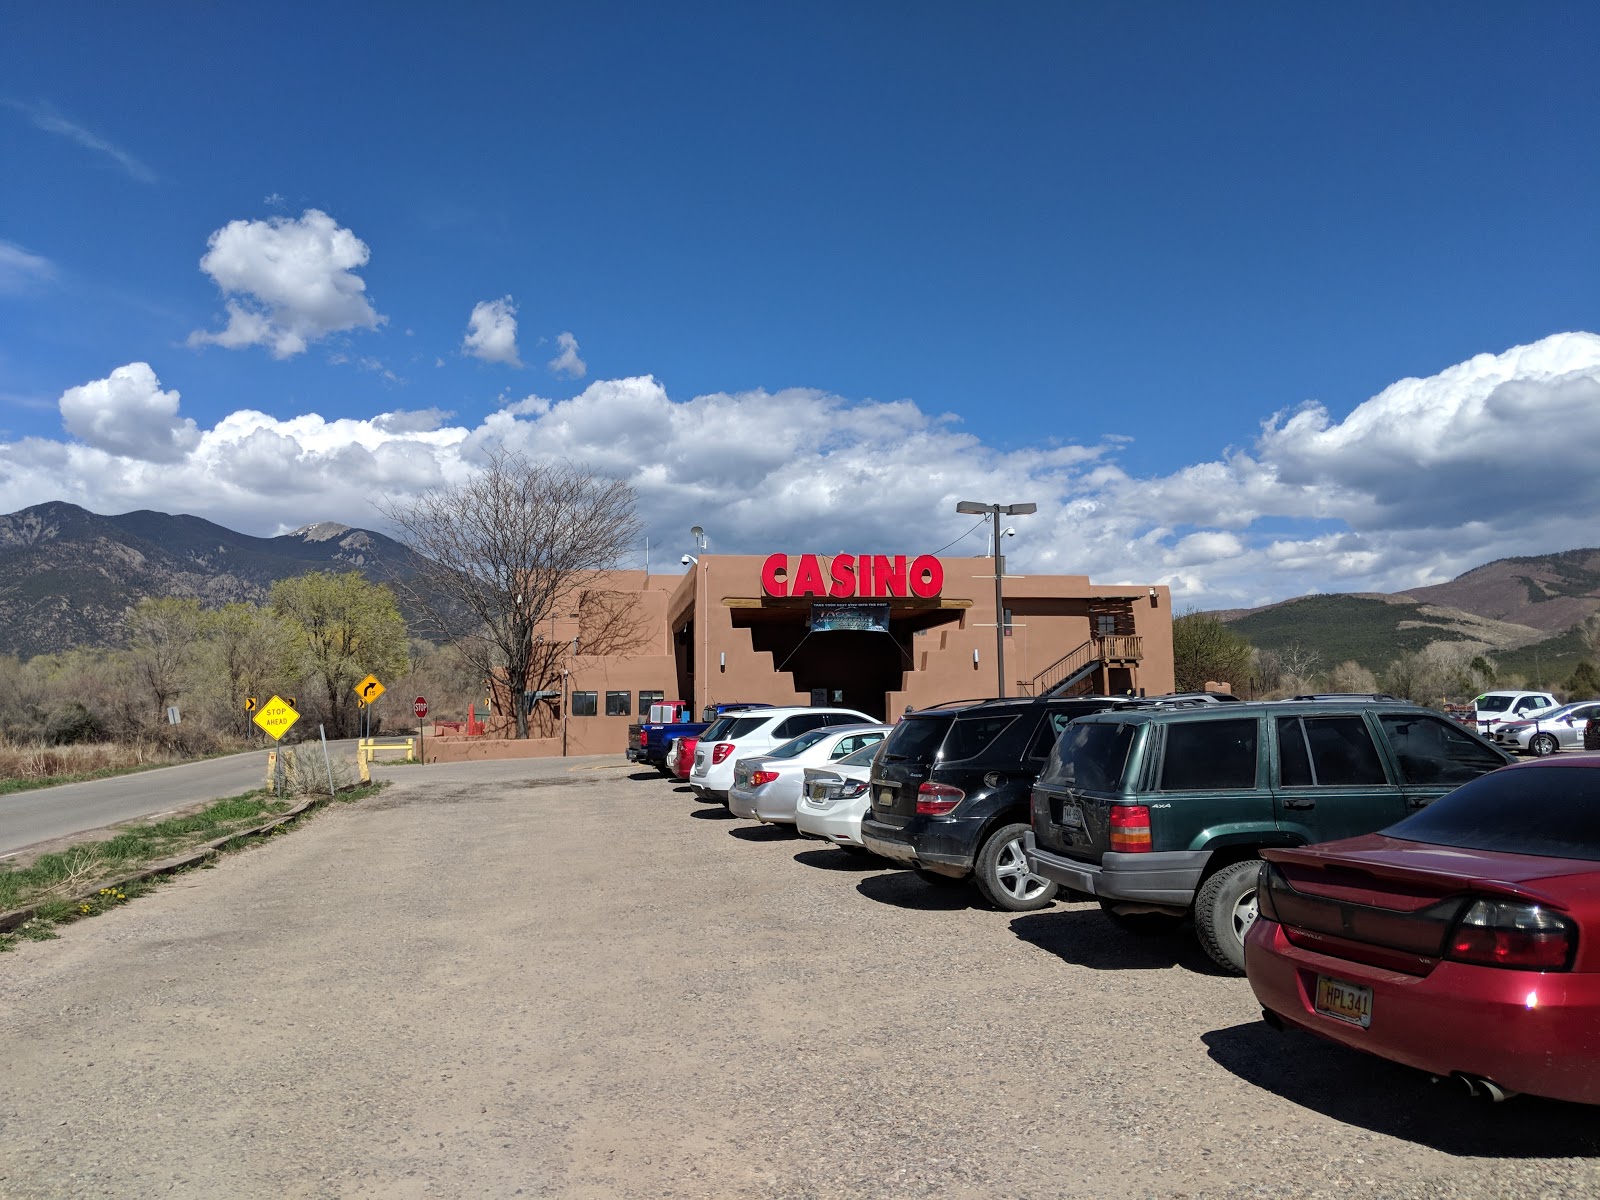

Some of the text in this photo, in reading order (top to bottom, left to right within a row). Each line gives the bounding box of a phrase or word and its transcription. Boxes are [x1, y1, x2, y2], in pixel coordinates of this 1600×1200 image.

[761, 553, 944, 598] CASINO
[266, 708, 286, 716] STOP
[414, 702, 427, 712] STOP
[266, 717, 288, 726] AHEAD
[1326, 985, 1368, 1015] HPL341
